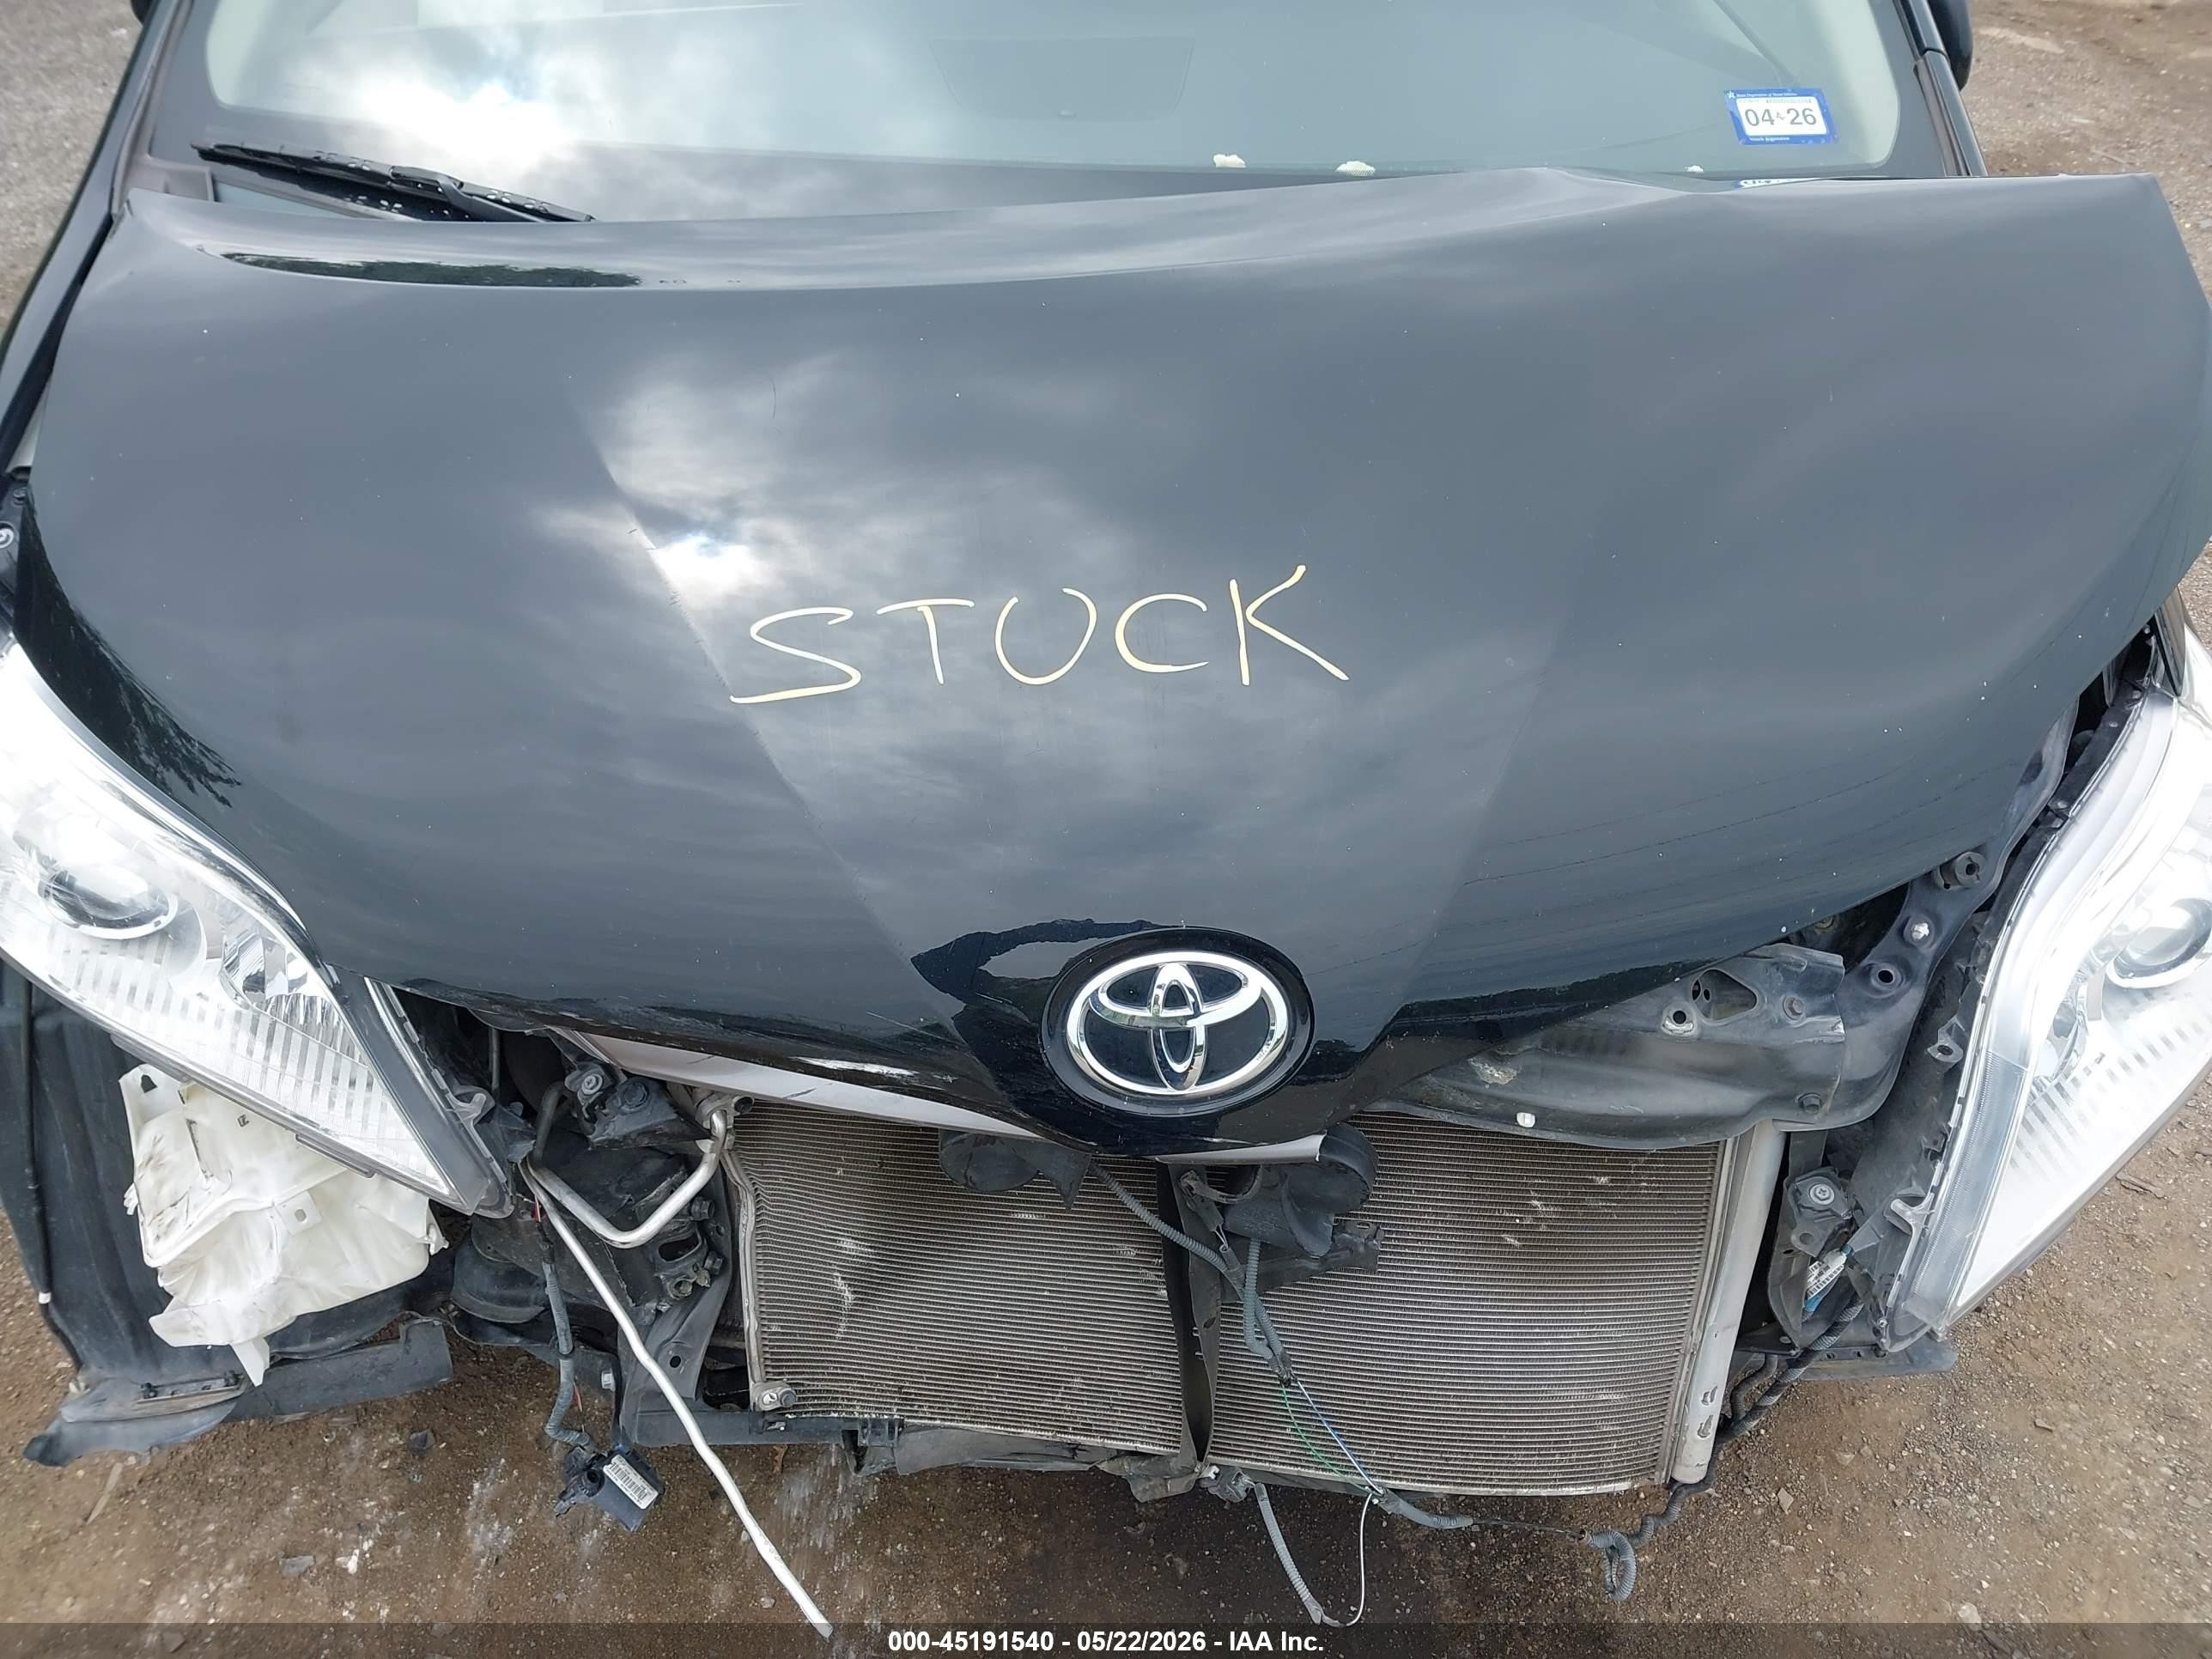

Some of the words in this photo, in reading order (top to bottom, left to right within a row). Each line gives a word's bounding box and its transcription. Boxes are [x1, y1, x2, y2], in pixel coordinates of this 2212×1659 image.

[1744, 108, 1775, 126] 04
[1786, 107, 1817, 125] 26
[730, 564, 1350, 704] STUCK
